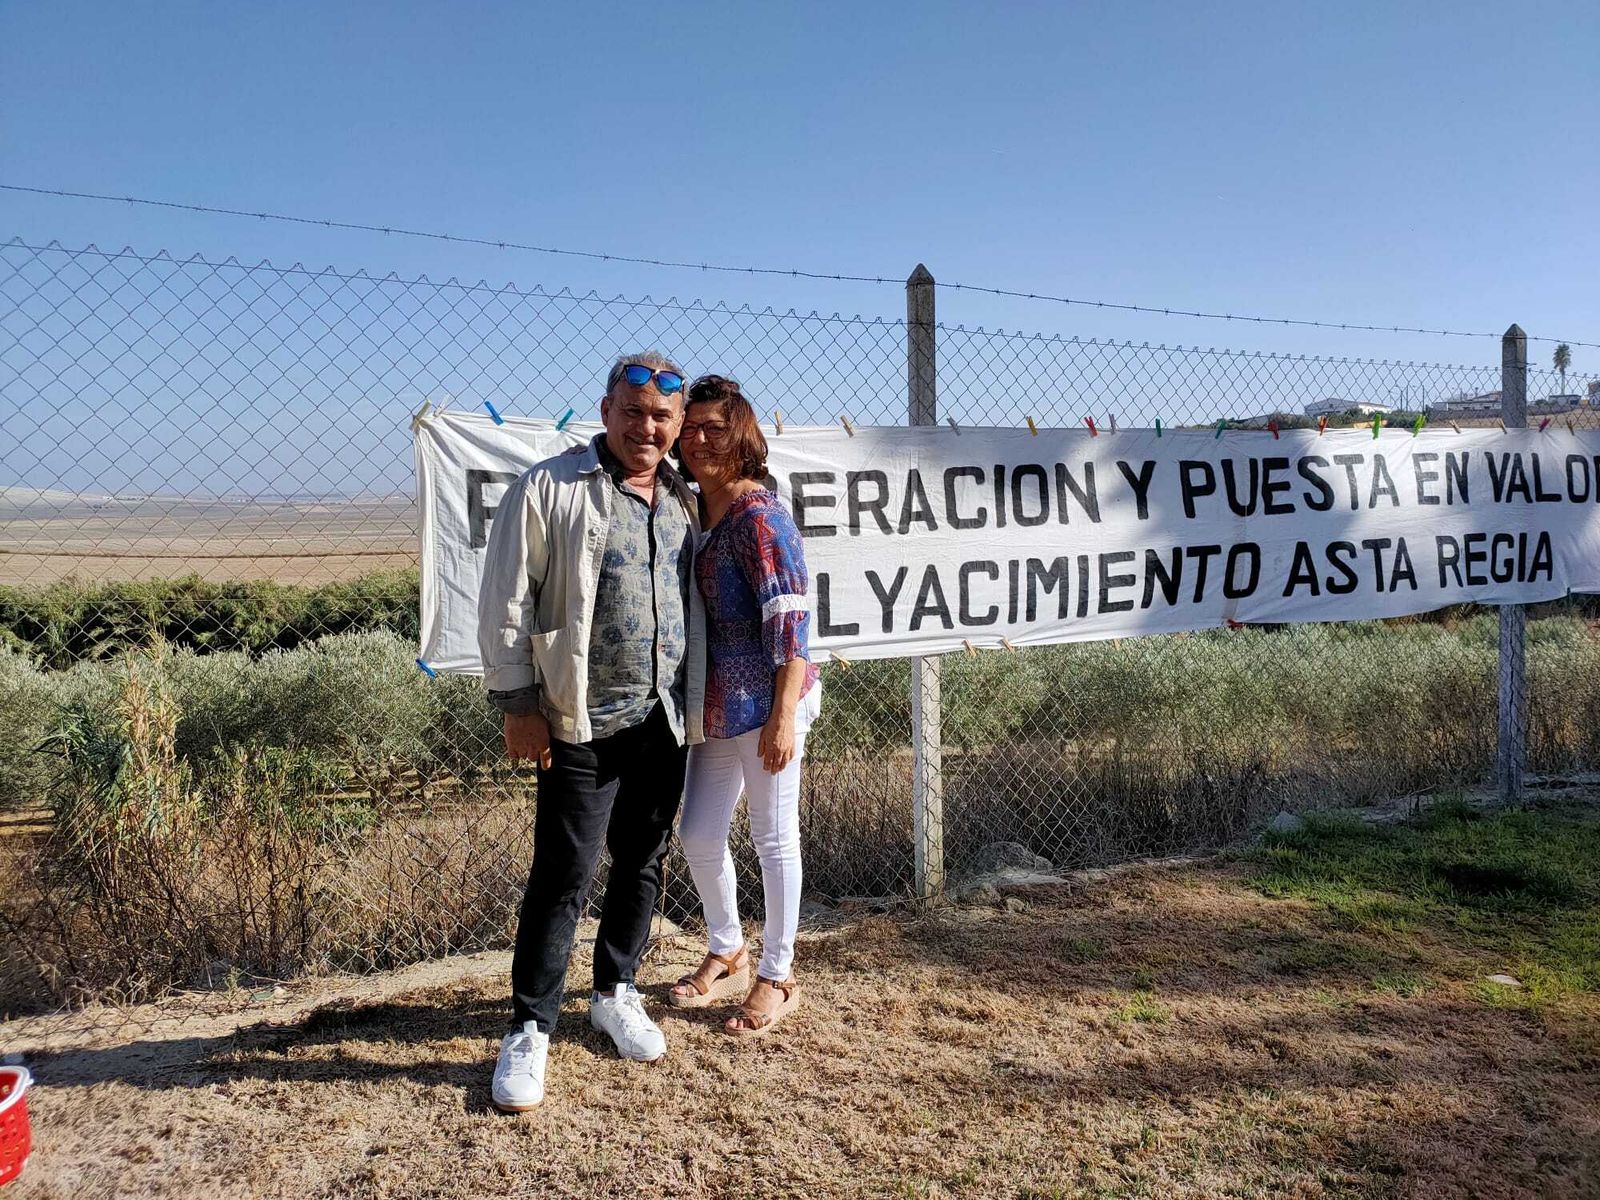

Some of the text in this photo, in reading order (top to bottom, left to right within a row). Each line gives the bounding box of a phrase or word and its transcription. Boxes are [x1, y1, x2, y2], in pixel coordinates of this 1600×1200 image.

[1116, 460, 1156, 520] Y
[1180, 454, 1400, 519] PUESTA
[1412, 452, 1470, 505] EN
[1282, 537, 1418, 598] ASTA
[1435, 531, 1553, 588] REGIA
